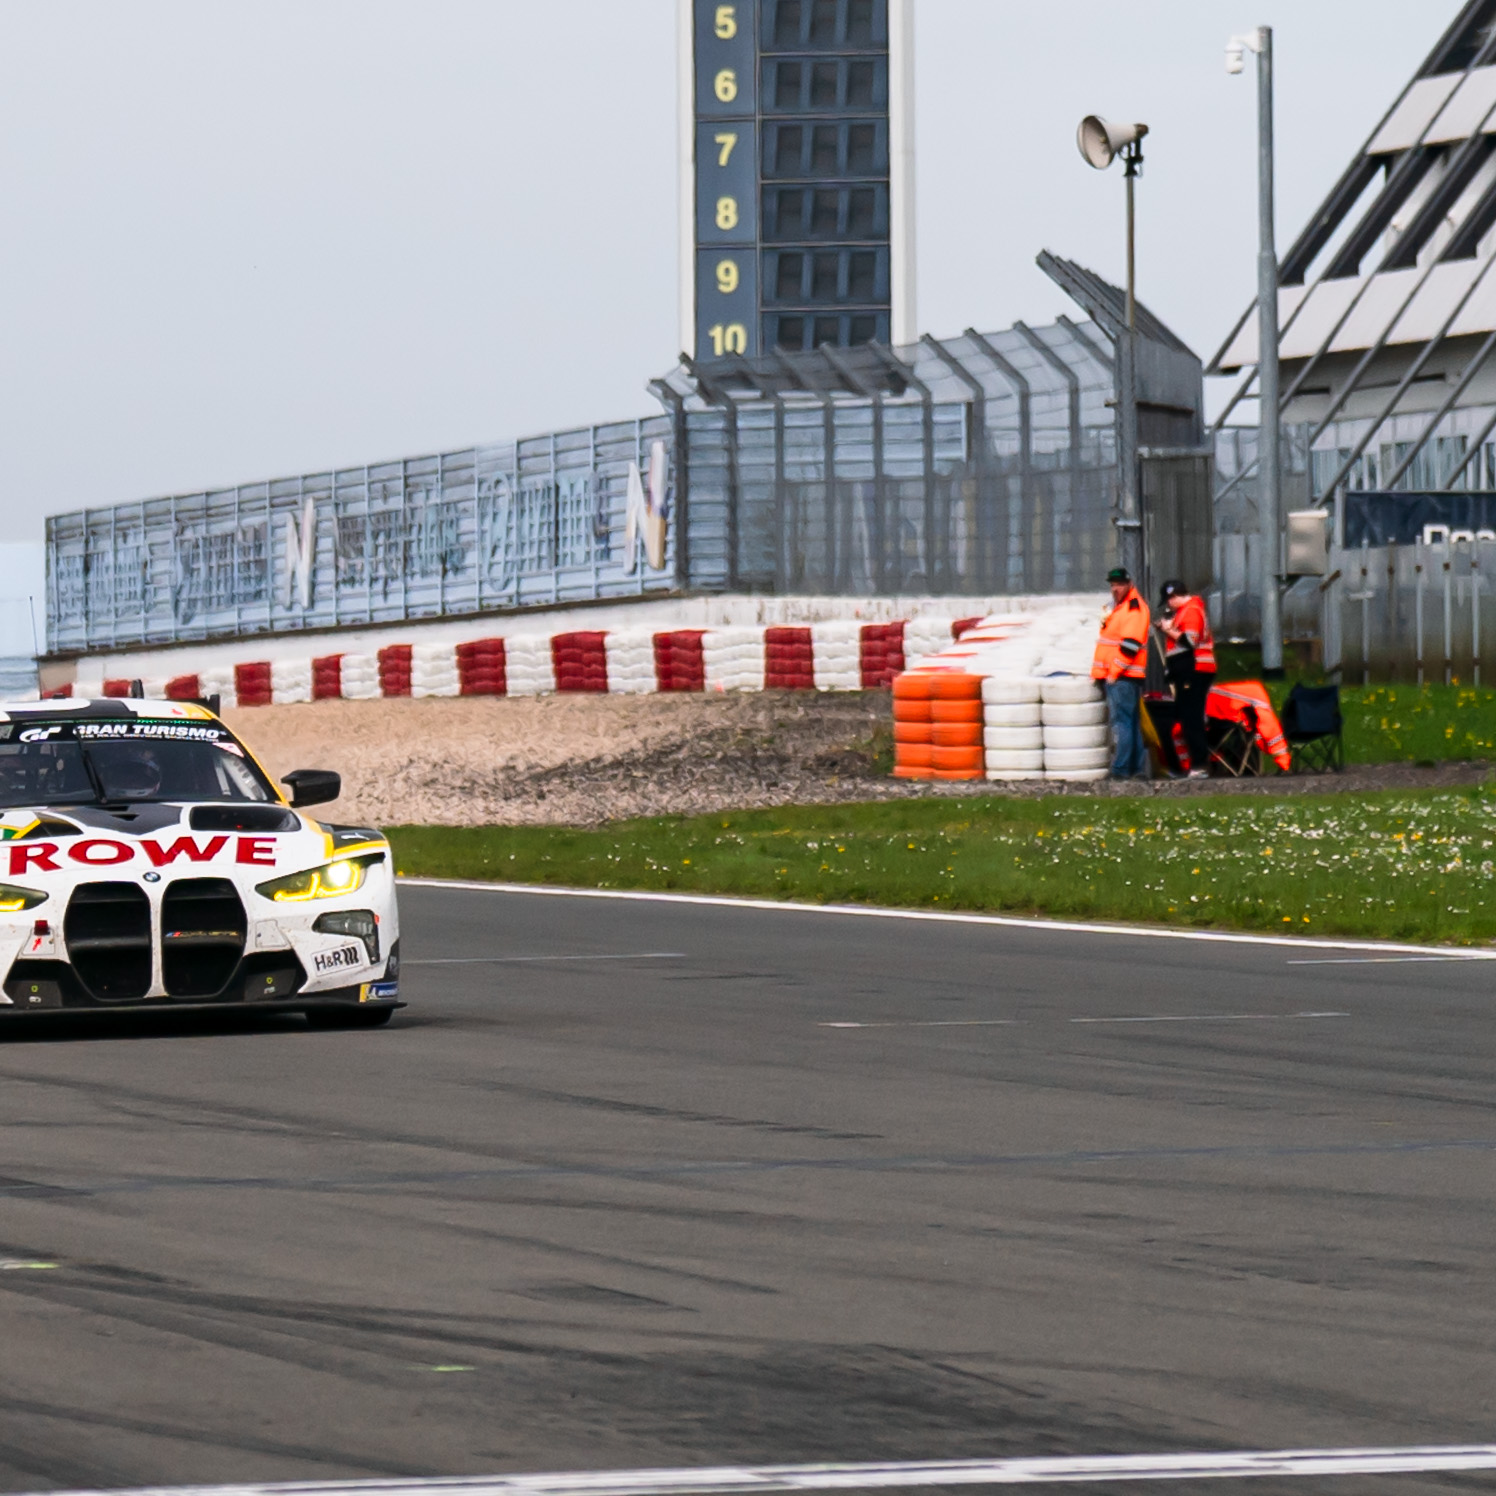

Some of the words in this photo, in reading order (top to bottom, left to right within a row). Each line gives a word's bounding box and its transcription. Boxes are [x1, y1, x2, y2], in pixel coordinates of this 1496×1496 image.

[714, 6, 737, 39] 5
[714, 69, 737, 102] 6
[714, 133, 737, 167] 7
[716, 197, 738, 230] 8
[716, 260, 739, 293] 9
[709, 323, 746, 356] 10
[132, 724, 219, 739] TURISMO
[9, 835, 277, 876] ROWE
[314, 951, 343, 971] H&R
